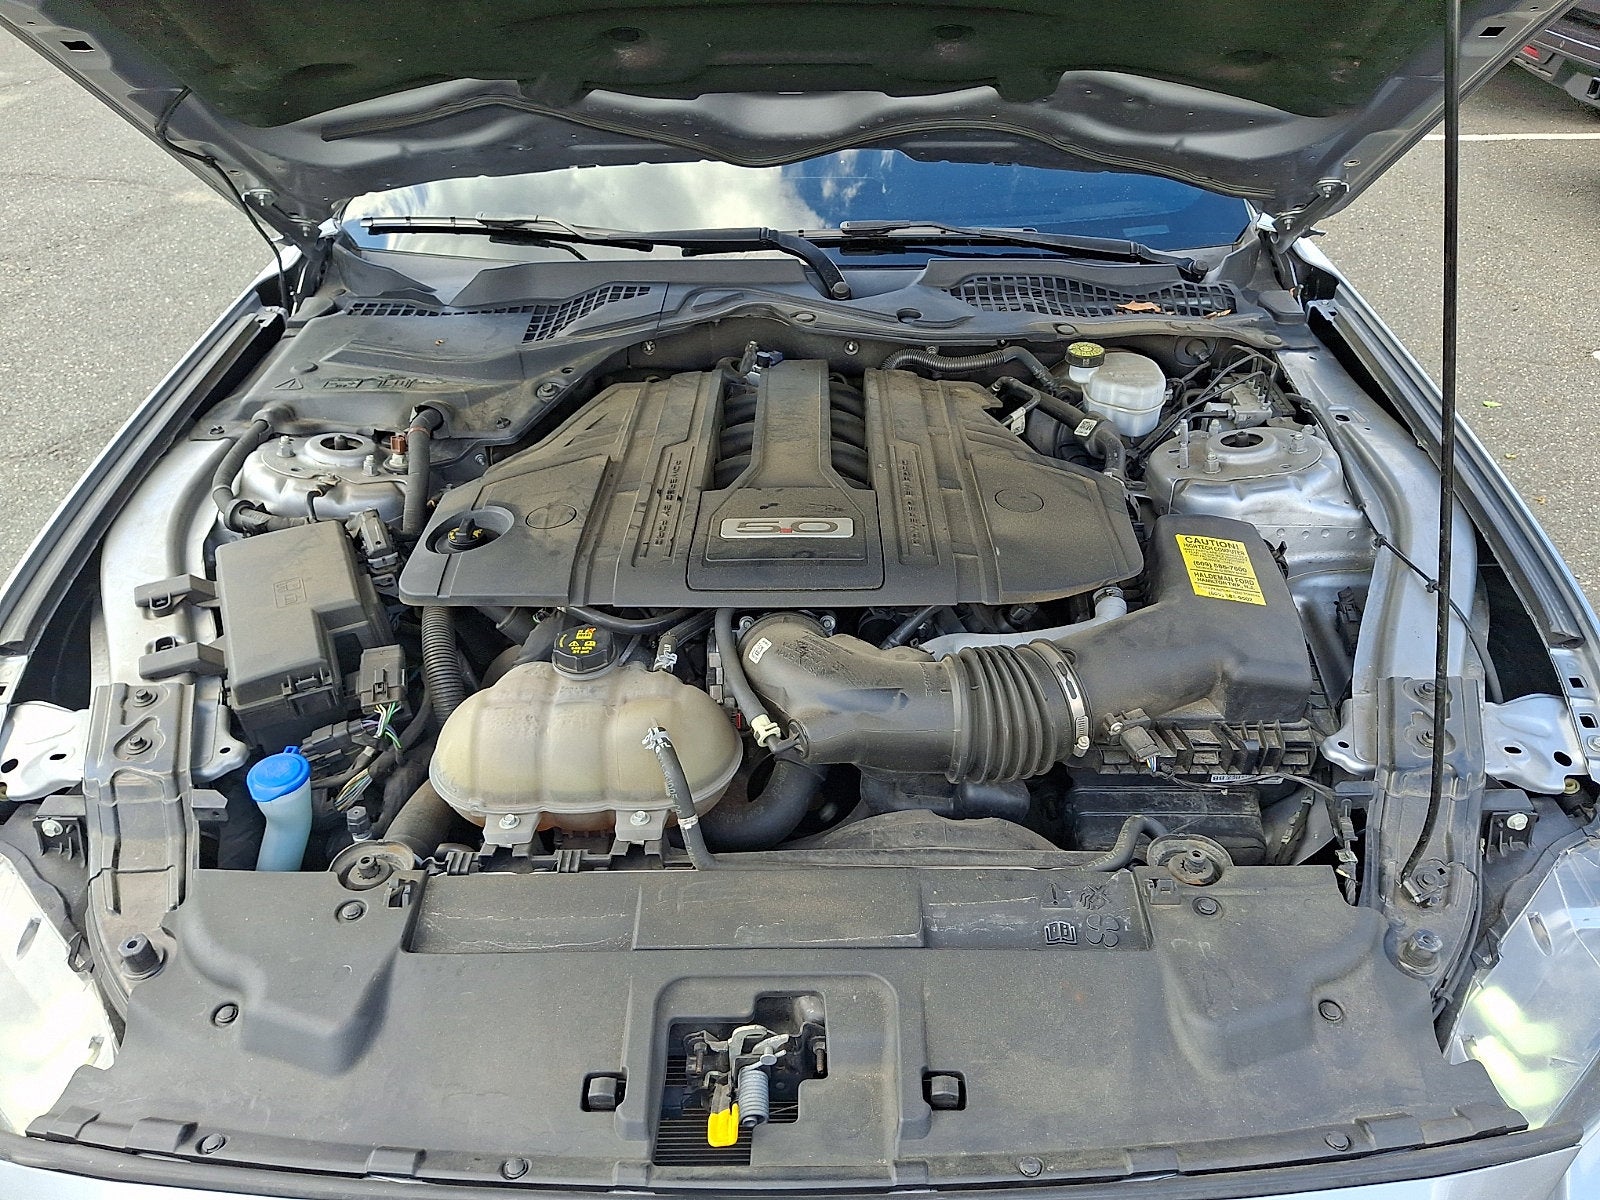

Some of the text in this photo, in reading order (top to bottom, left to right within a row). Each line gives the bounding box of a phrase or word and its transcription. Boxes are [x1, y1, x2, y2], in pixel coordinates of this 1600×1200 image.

[735, 520, 839, 534] 5.0
[1183, 536, 1239, 549] CAUTION!
[1234, 577, 1255, 585] FORD
